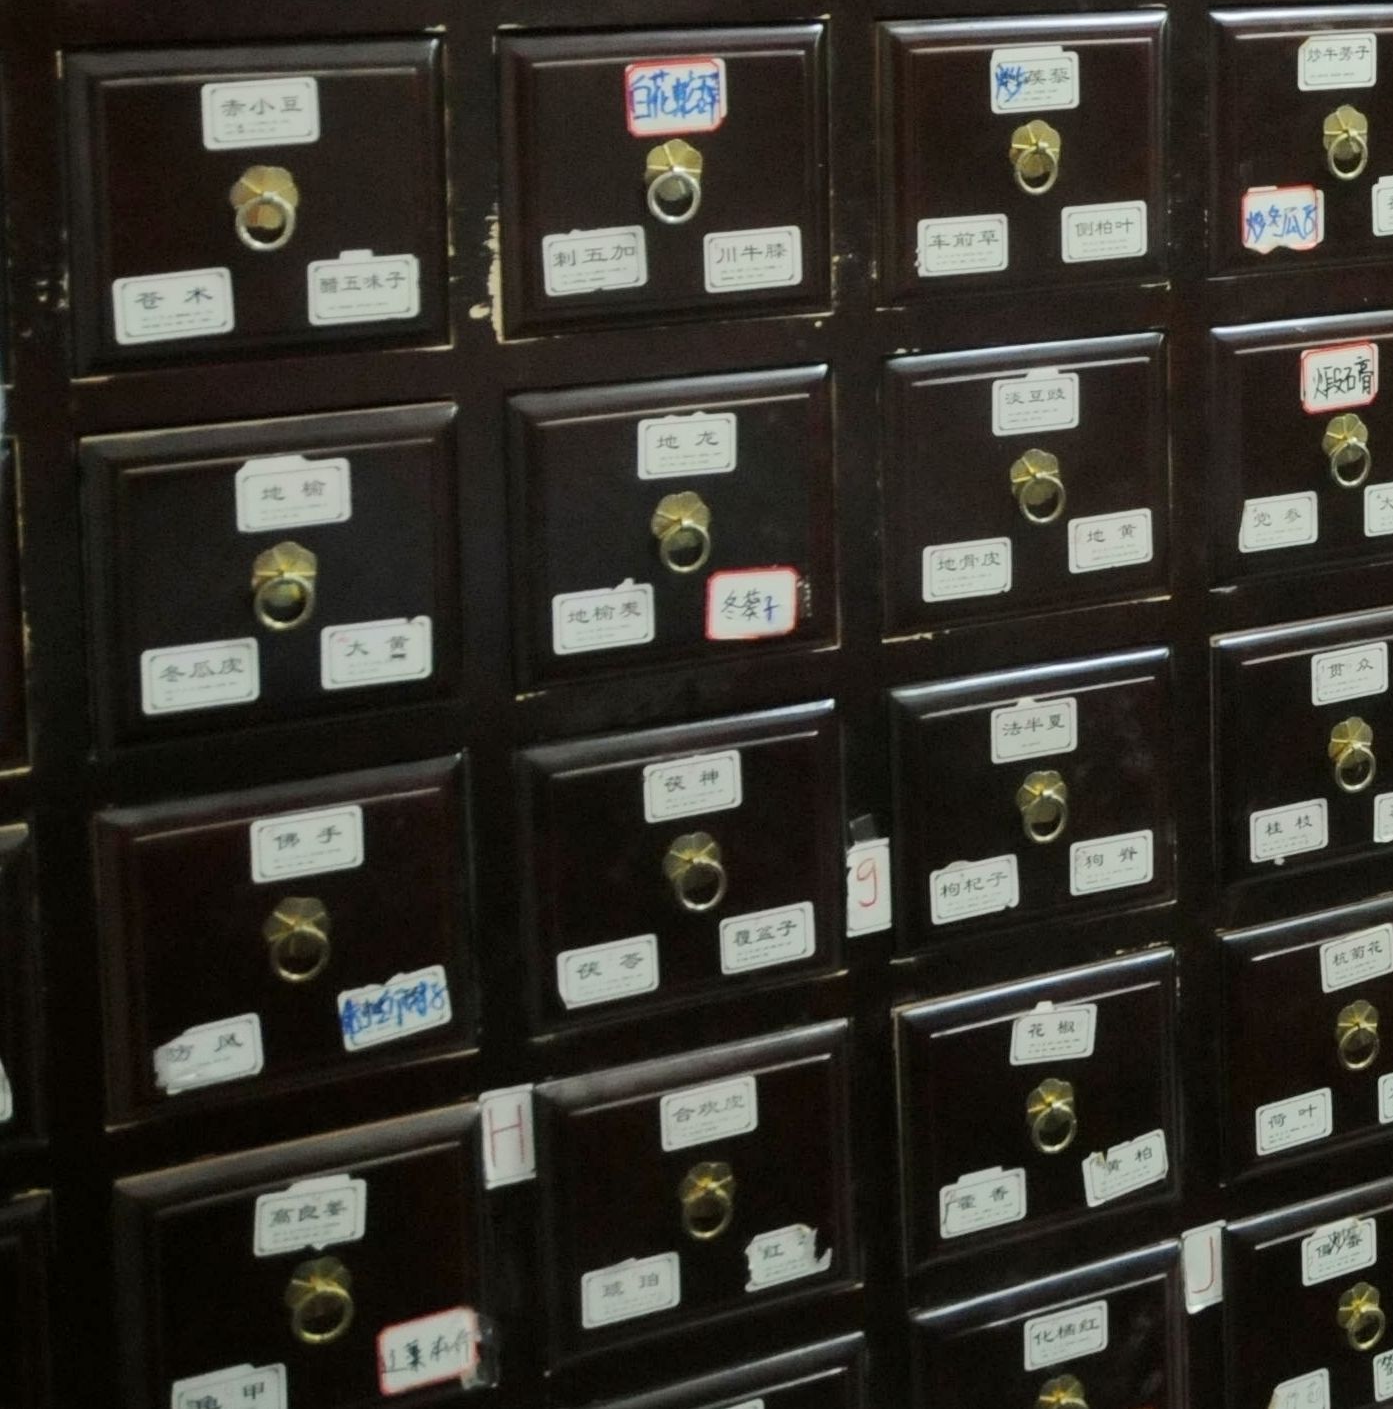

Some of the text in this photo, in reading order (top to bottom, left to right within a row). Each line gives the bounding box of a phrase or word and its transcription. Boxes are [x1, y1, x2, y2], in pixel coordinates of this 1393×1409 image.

[1306, 43, 1370, 63] 炒牛蒡子
[219, 94, 303, 118] 赤小豆
[927, 228, 1000, 250] 车前草
[1073, 216, 1135, 238] 侧柏叶
[552, 243, 638, 268] 刺五加
[714, 241, 787, 265] 川牛膝
[318, 270, 406, 294] 醋五味子
[655, 429, 720, 450] 地龙
[260, 478, 326, 502] 地榆
[1252, 506, 1302, 529] 党参
[1086, 524, 1136, 543] 地黄
[936, 550, 1001, 572] 地骨皮
[566, 599, 642, 625] 地榆炭
[344, 634, 410, 658] 大黄
[158, 656, 244, 683] 冬瓜皮
[1326, 657, 1373, 678] 贯众
[1003, 715, 1069, 737] 法半夏
[663, 767, 720, 793] 茯神
[1264, 813, 1313, 837] 桂枝
[272, 824, 342, 851] 佛手
[1084, 845, 1138, 869] 狗脊
[939, 870, 1008, 899] 枸杞子
[732, 918, 798, 947] 覆盆子
[1331, 938, 1383, 967] 杭菊花
[574, 950, 644, 981] 茯苓
[1026, 1019, 1075, 1038] 花椒
[671, 1093, 745, 1124] 合欢皮
[1266, 1102, 1318, 1129] 荷叶
[269, 1198, 347, 1227] 高良姜
[1032, 1317, 1101, 1346] 化橘红
